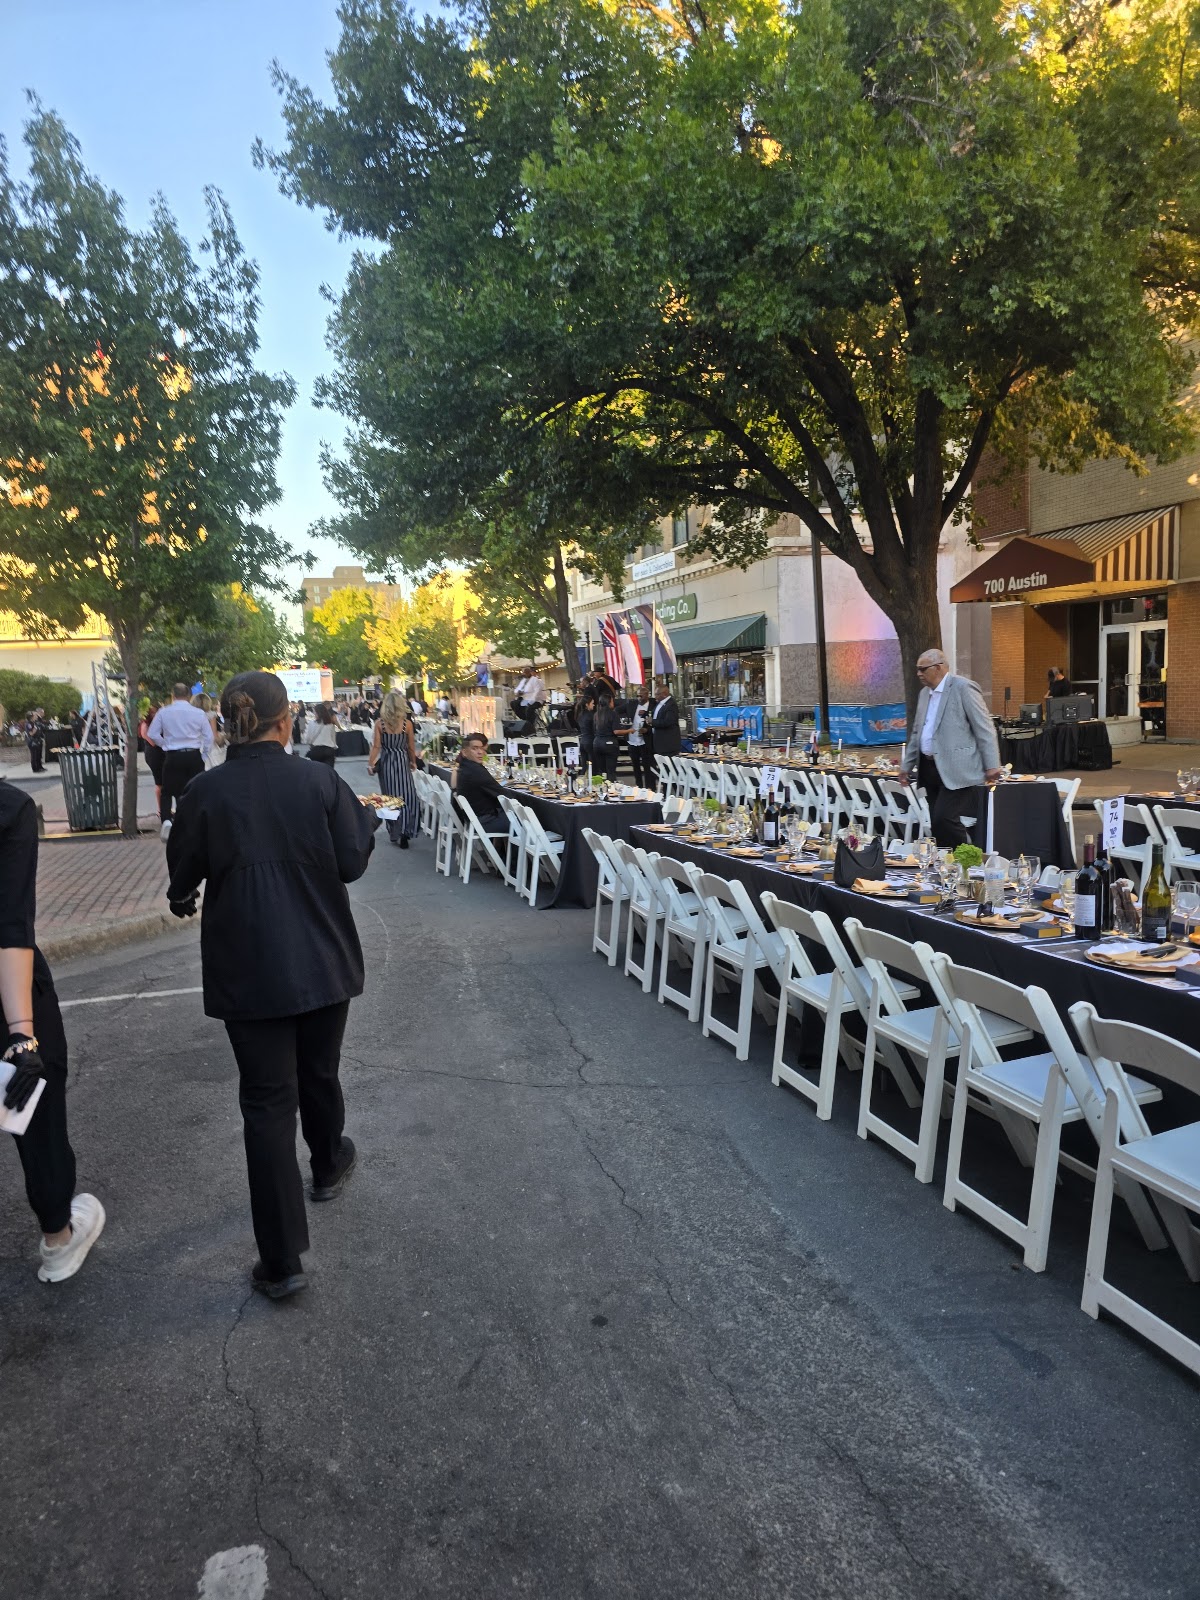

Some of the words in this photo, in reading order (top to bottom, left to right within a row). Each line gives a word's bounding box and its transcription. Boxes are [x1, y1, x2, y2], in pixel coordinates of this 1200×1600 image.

[983, 577, 1005, 595] 700
[1007, 571, 1048, 591] Austin
[677, 599, 691, 615] Co.
[1109, 811, 1119, 823] 74
